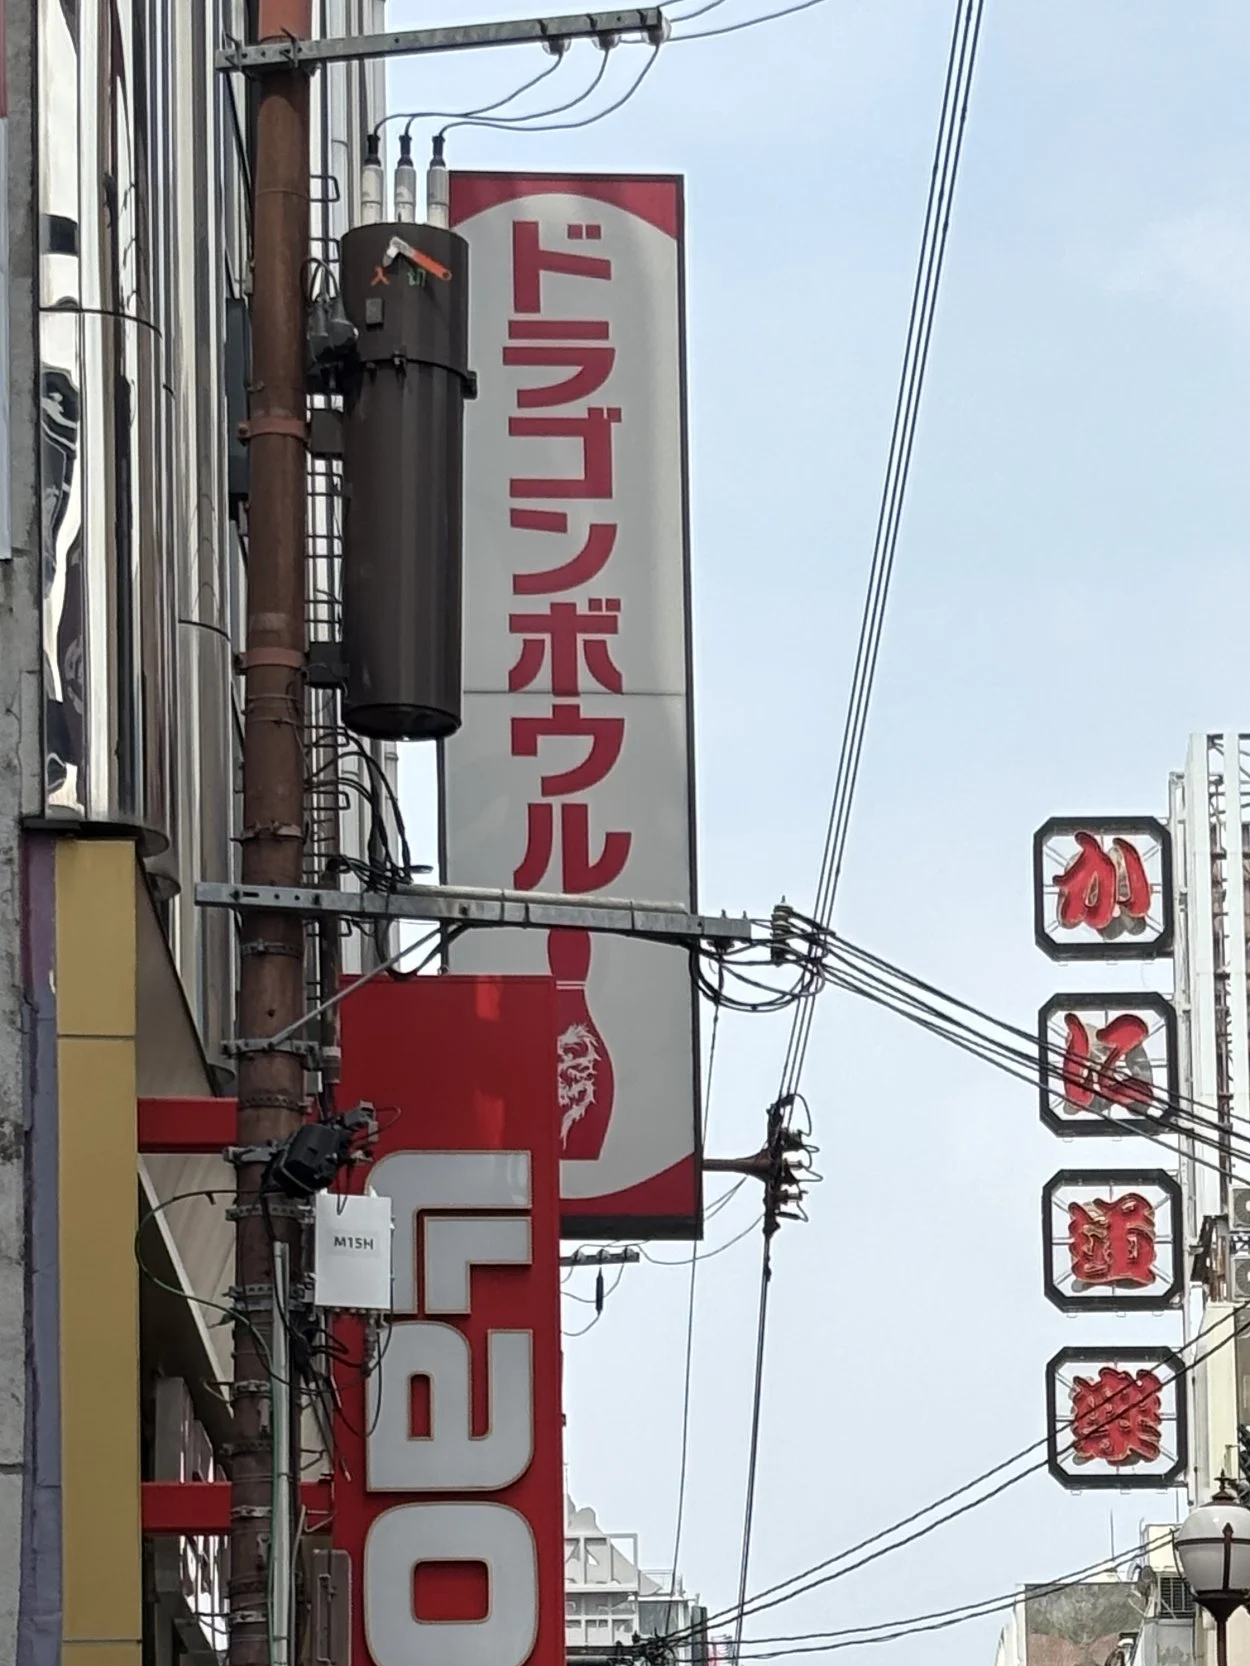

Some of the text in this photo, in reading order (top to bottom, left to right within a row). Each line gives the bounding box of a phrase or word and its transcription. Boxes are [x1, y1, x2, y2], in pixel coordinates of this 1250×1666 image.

[503, 219, 632, 892] ドラゴンボウル
[333, 1234, 375, 1250] M15H
